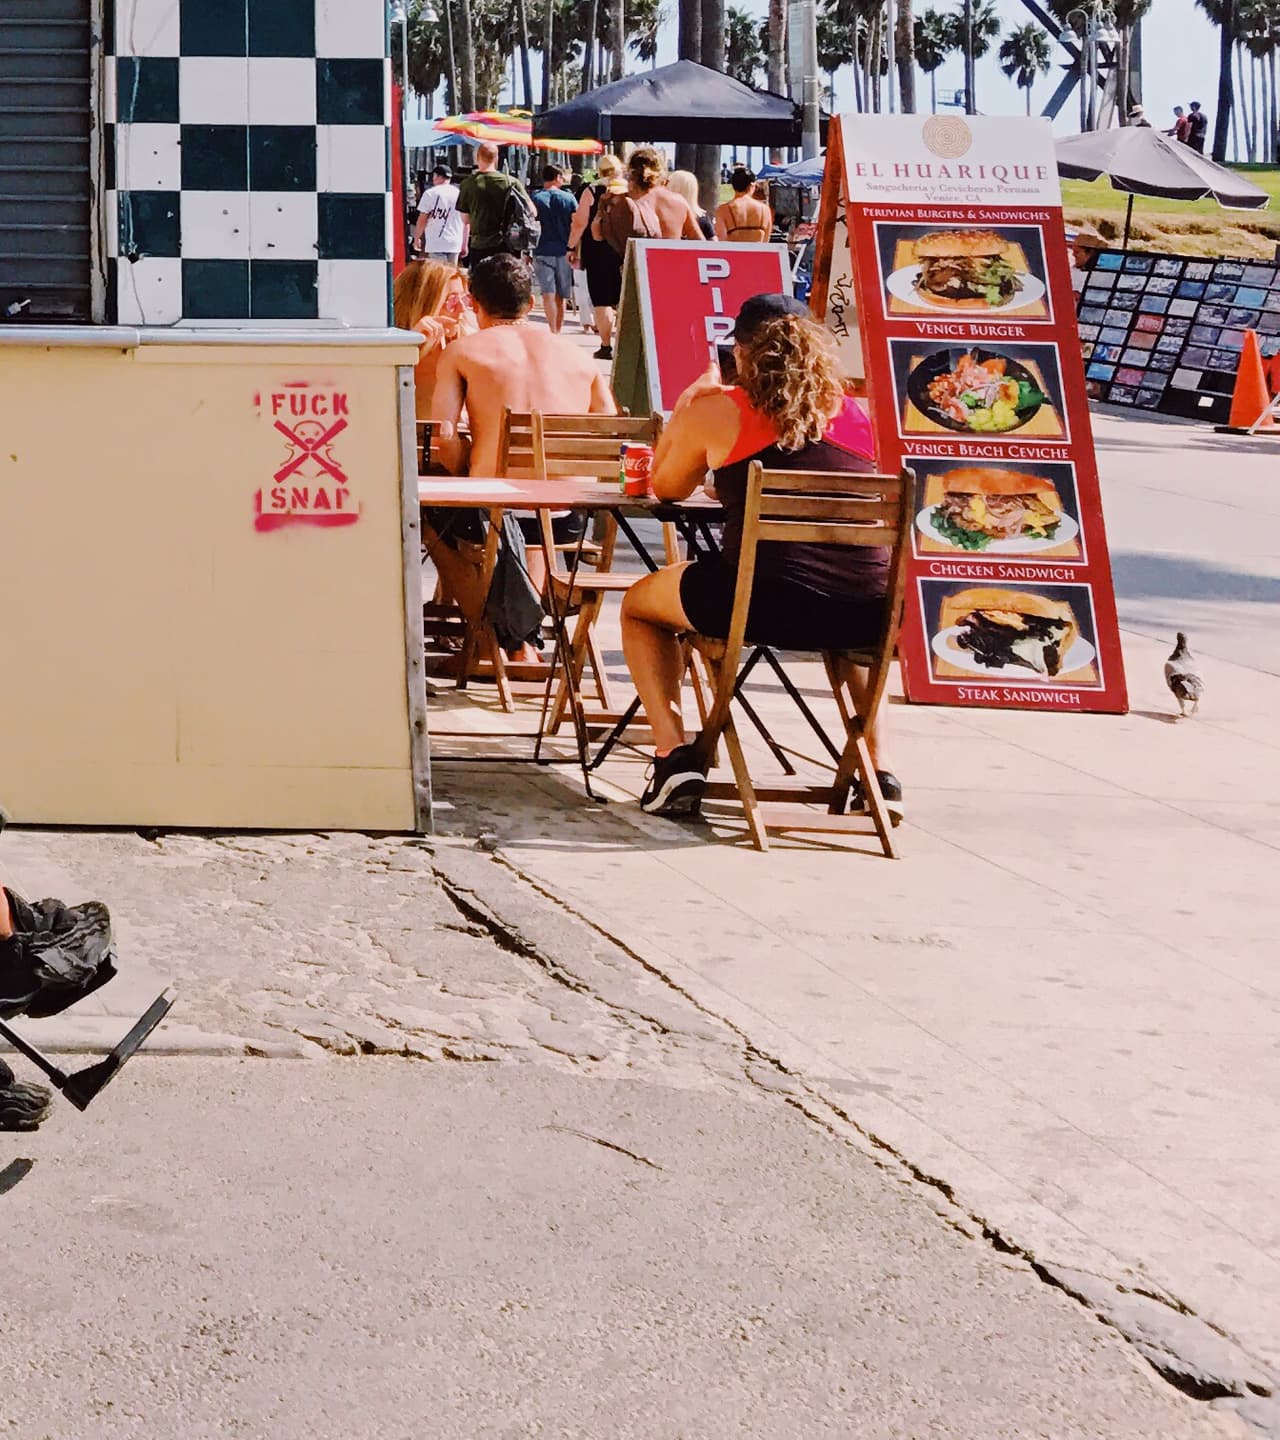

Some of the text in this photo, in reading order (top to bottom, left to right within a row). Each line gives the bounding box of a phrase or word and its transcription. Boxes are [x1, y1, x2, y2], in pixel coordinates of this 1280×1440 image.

[855, 162, 1049, 184] EL HUARIQUE
[965, 193, 982, 203] CA
[862, 207, 1051, 221] PERUVIAN BURGERS & SANDWICHES
[916, 322, 1026, 338] VENICE BURGER
[271, 392, 350, 416] FUCK
[904, 442, 1069, 460] VENICE BEACH CEVICHE
[929, 562, 1076, 581] CHICKEN SANDWICH
[957, 687, 1081, 705] STEAK SANDWICH
